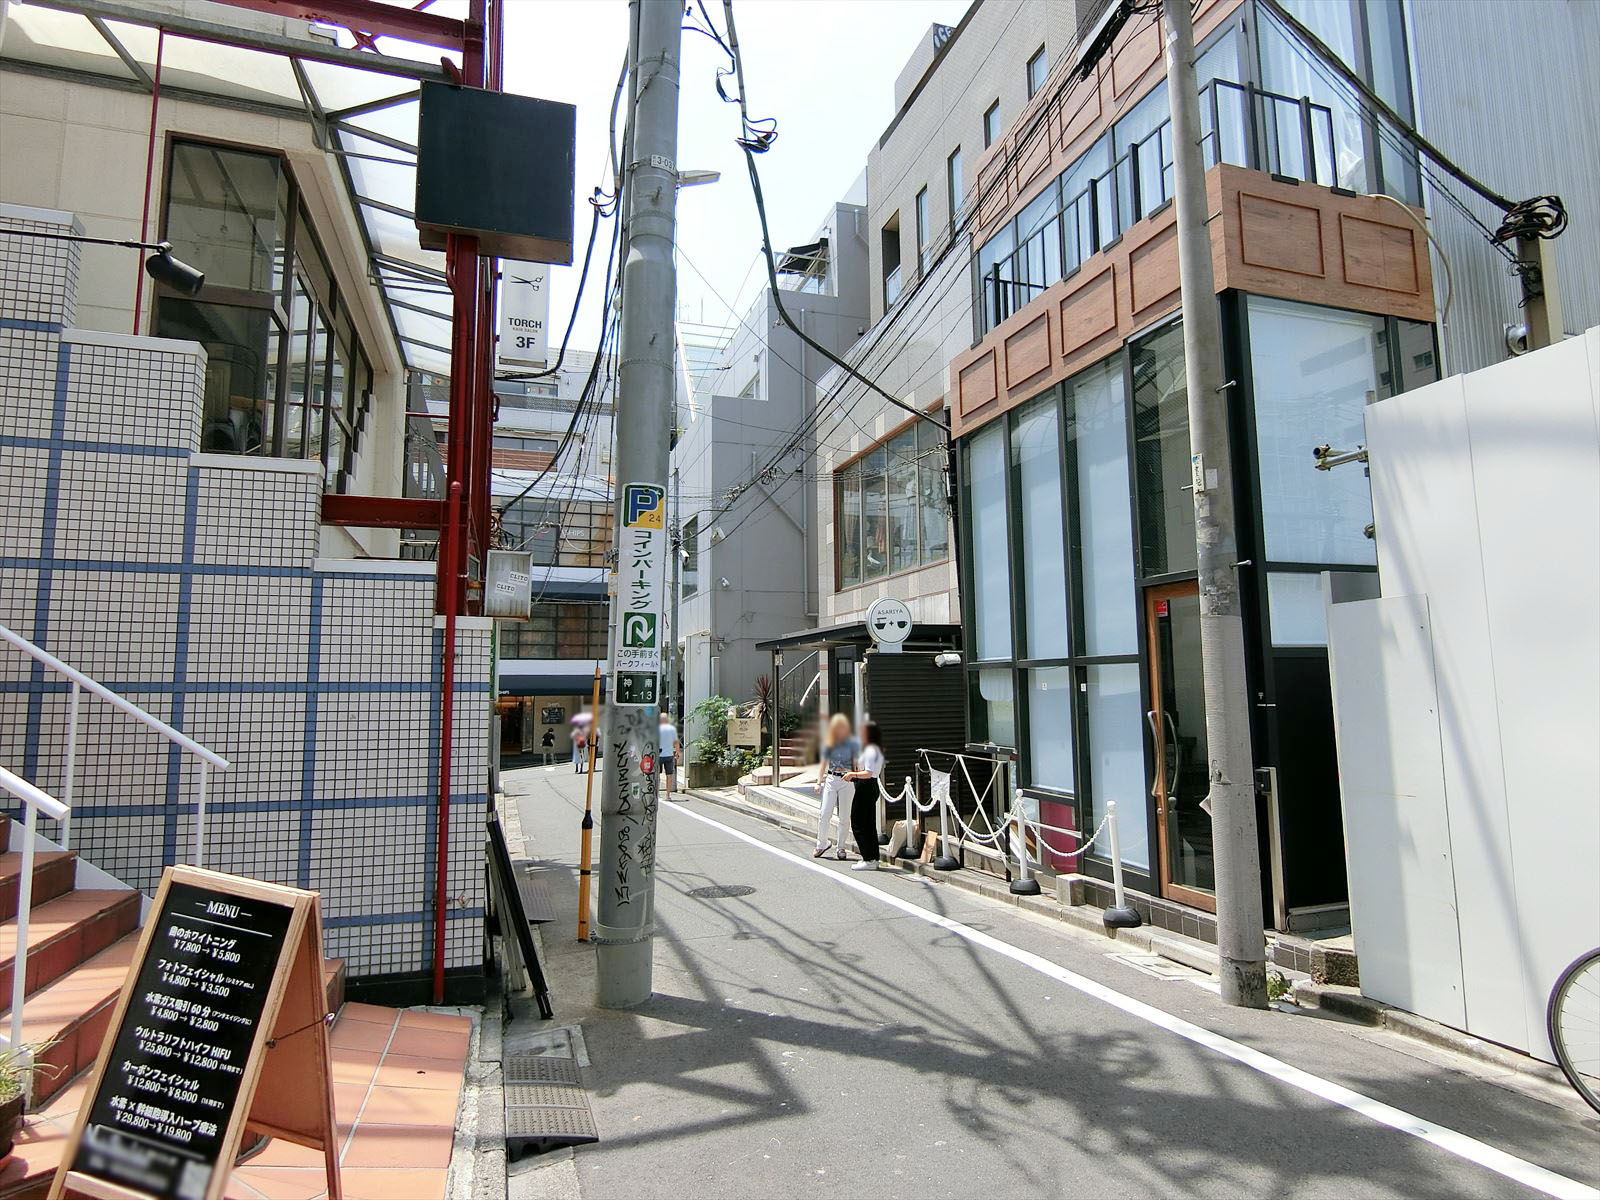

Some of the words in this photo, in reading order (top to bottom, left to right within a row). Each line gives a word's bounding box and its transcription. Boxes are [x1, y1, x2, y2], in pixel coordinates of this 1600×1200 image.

[508, 318, 542, 329] TORCH
[516, 336, 535, 349] 3F
[629, 488, 659, 523] P
[649, 514, 660, 522] 24
[630, 530, 653, 610] コインパーキング
[497, 583, 515, 592] CLITO
[625, 691, 653, 700] 1-13
[206, 900, 240, 918] MENU
[174, 940, 201, 954] ¥7,800
[212, 948, 240, 963] ¥5,800
[159, 959, 224, 983] フォトフェイシャル
[162, 972, 190, 987] ¥4,800
[201, 982, 230, 996] ¥3,500
[151, 1006, 178, 1020] ¥4,800
[190, 1016, 219, 1031] ¥2,800
[136, 1026, 210, 1054] ウルトラリフトハイフ
[210, 1046, 231, 1060] HIFU
[140, 1039, 172, 1057] ¥25,800
[183, 1052, 218, 1070] ¥12,800
[123, 1060, 200, 1090] カーボンフェイシャル
[127, 1075, 160, 1093] ¥12,800
[168, 1086, 198, 1104] ¥8,900
[116, 1111, 149, 1129] ¥29,800
[156, 1123, 192, 1141] ¥19,800
